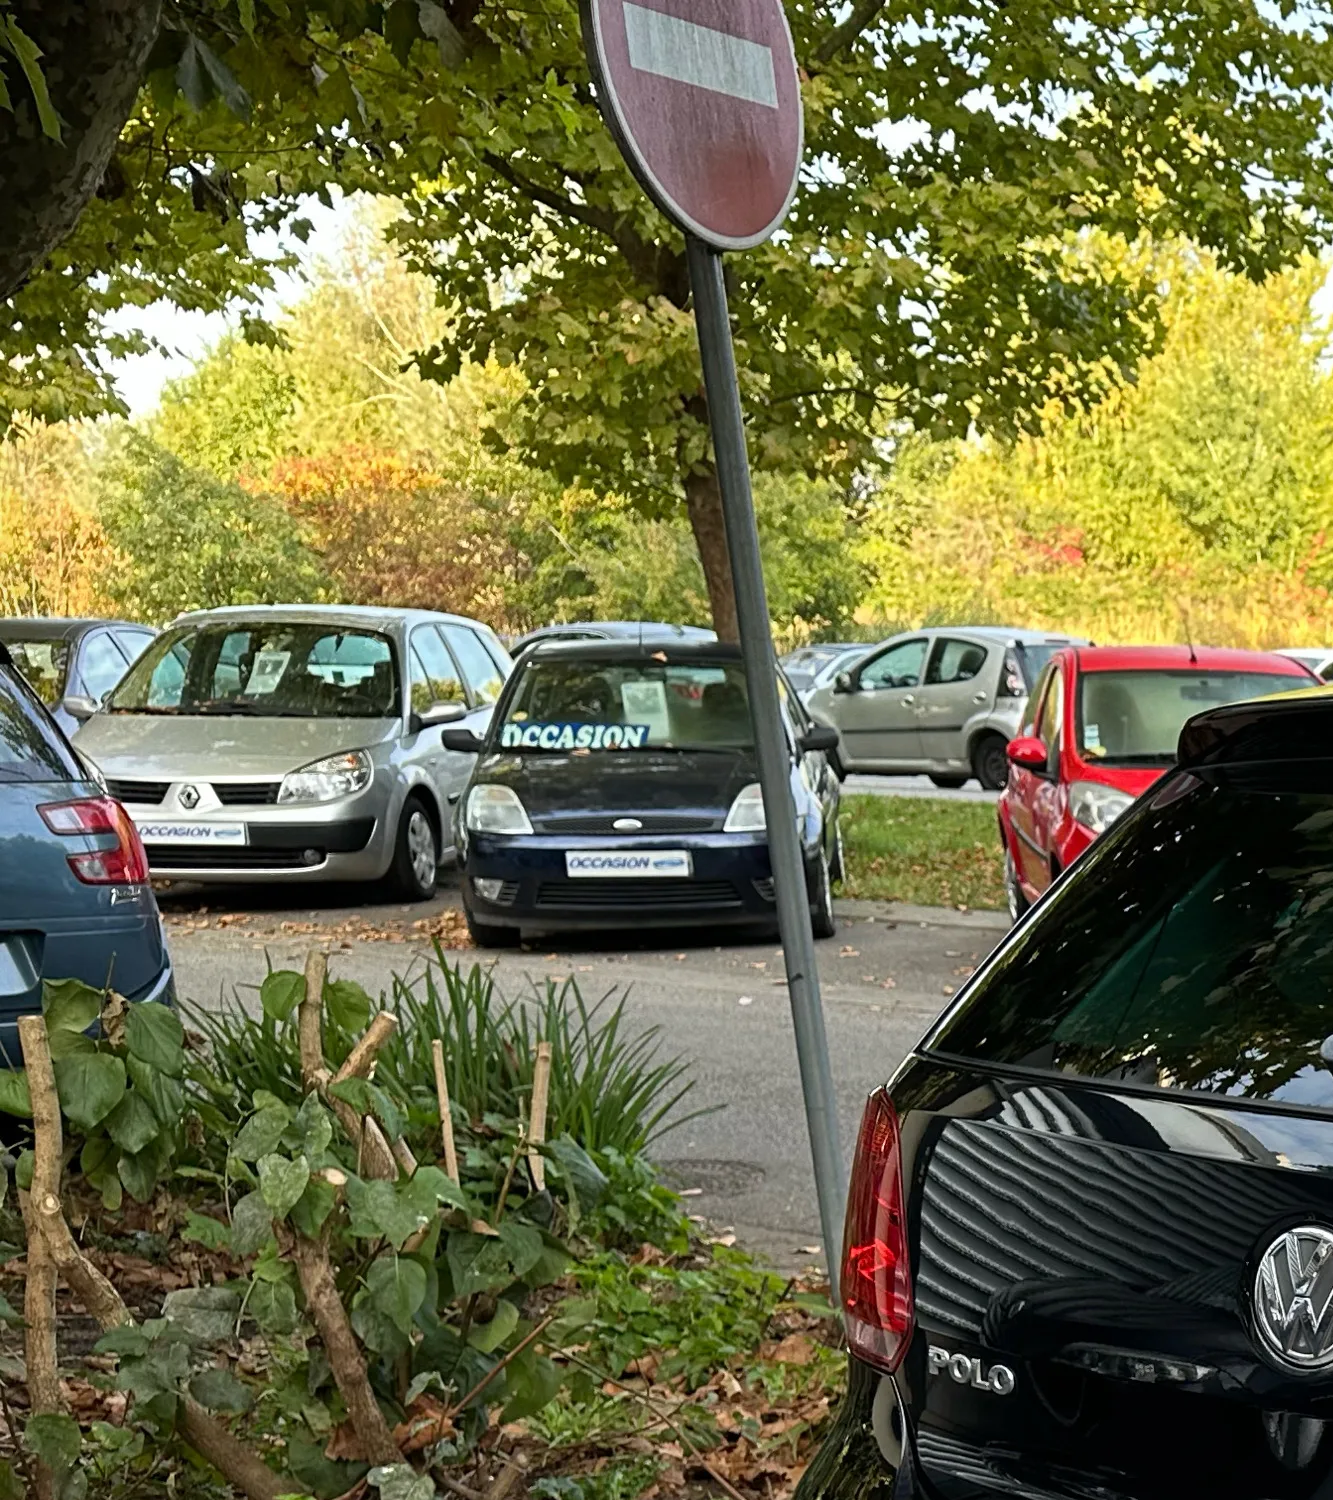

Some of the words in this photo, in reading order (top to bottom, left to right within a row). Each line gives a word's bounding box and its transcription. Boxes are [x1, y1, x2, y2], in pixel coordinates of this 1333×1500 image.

[501, 724, 646, 749] OCCASION
[139, 826, 211, 837] OCCASION
[569, 856, 650, 869] OCCASION
[928, 1344, 1015, 1396] POLO
